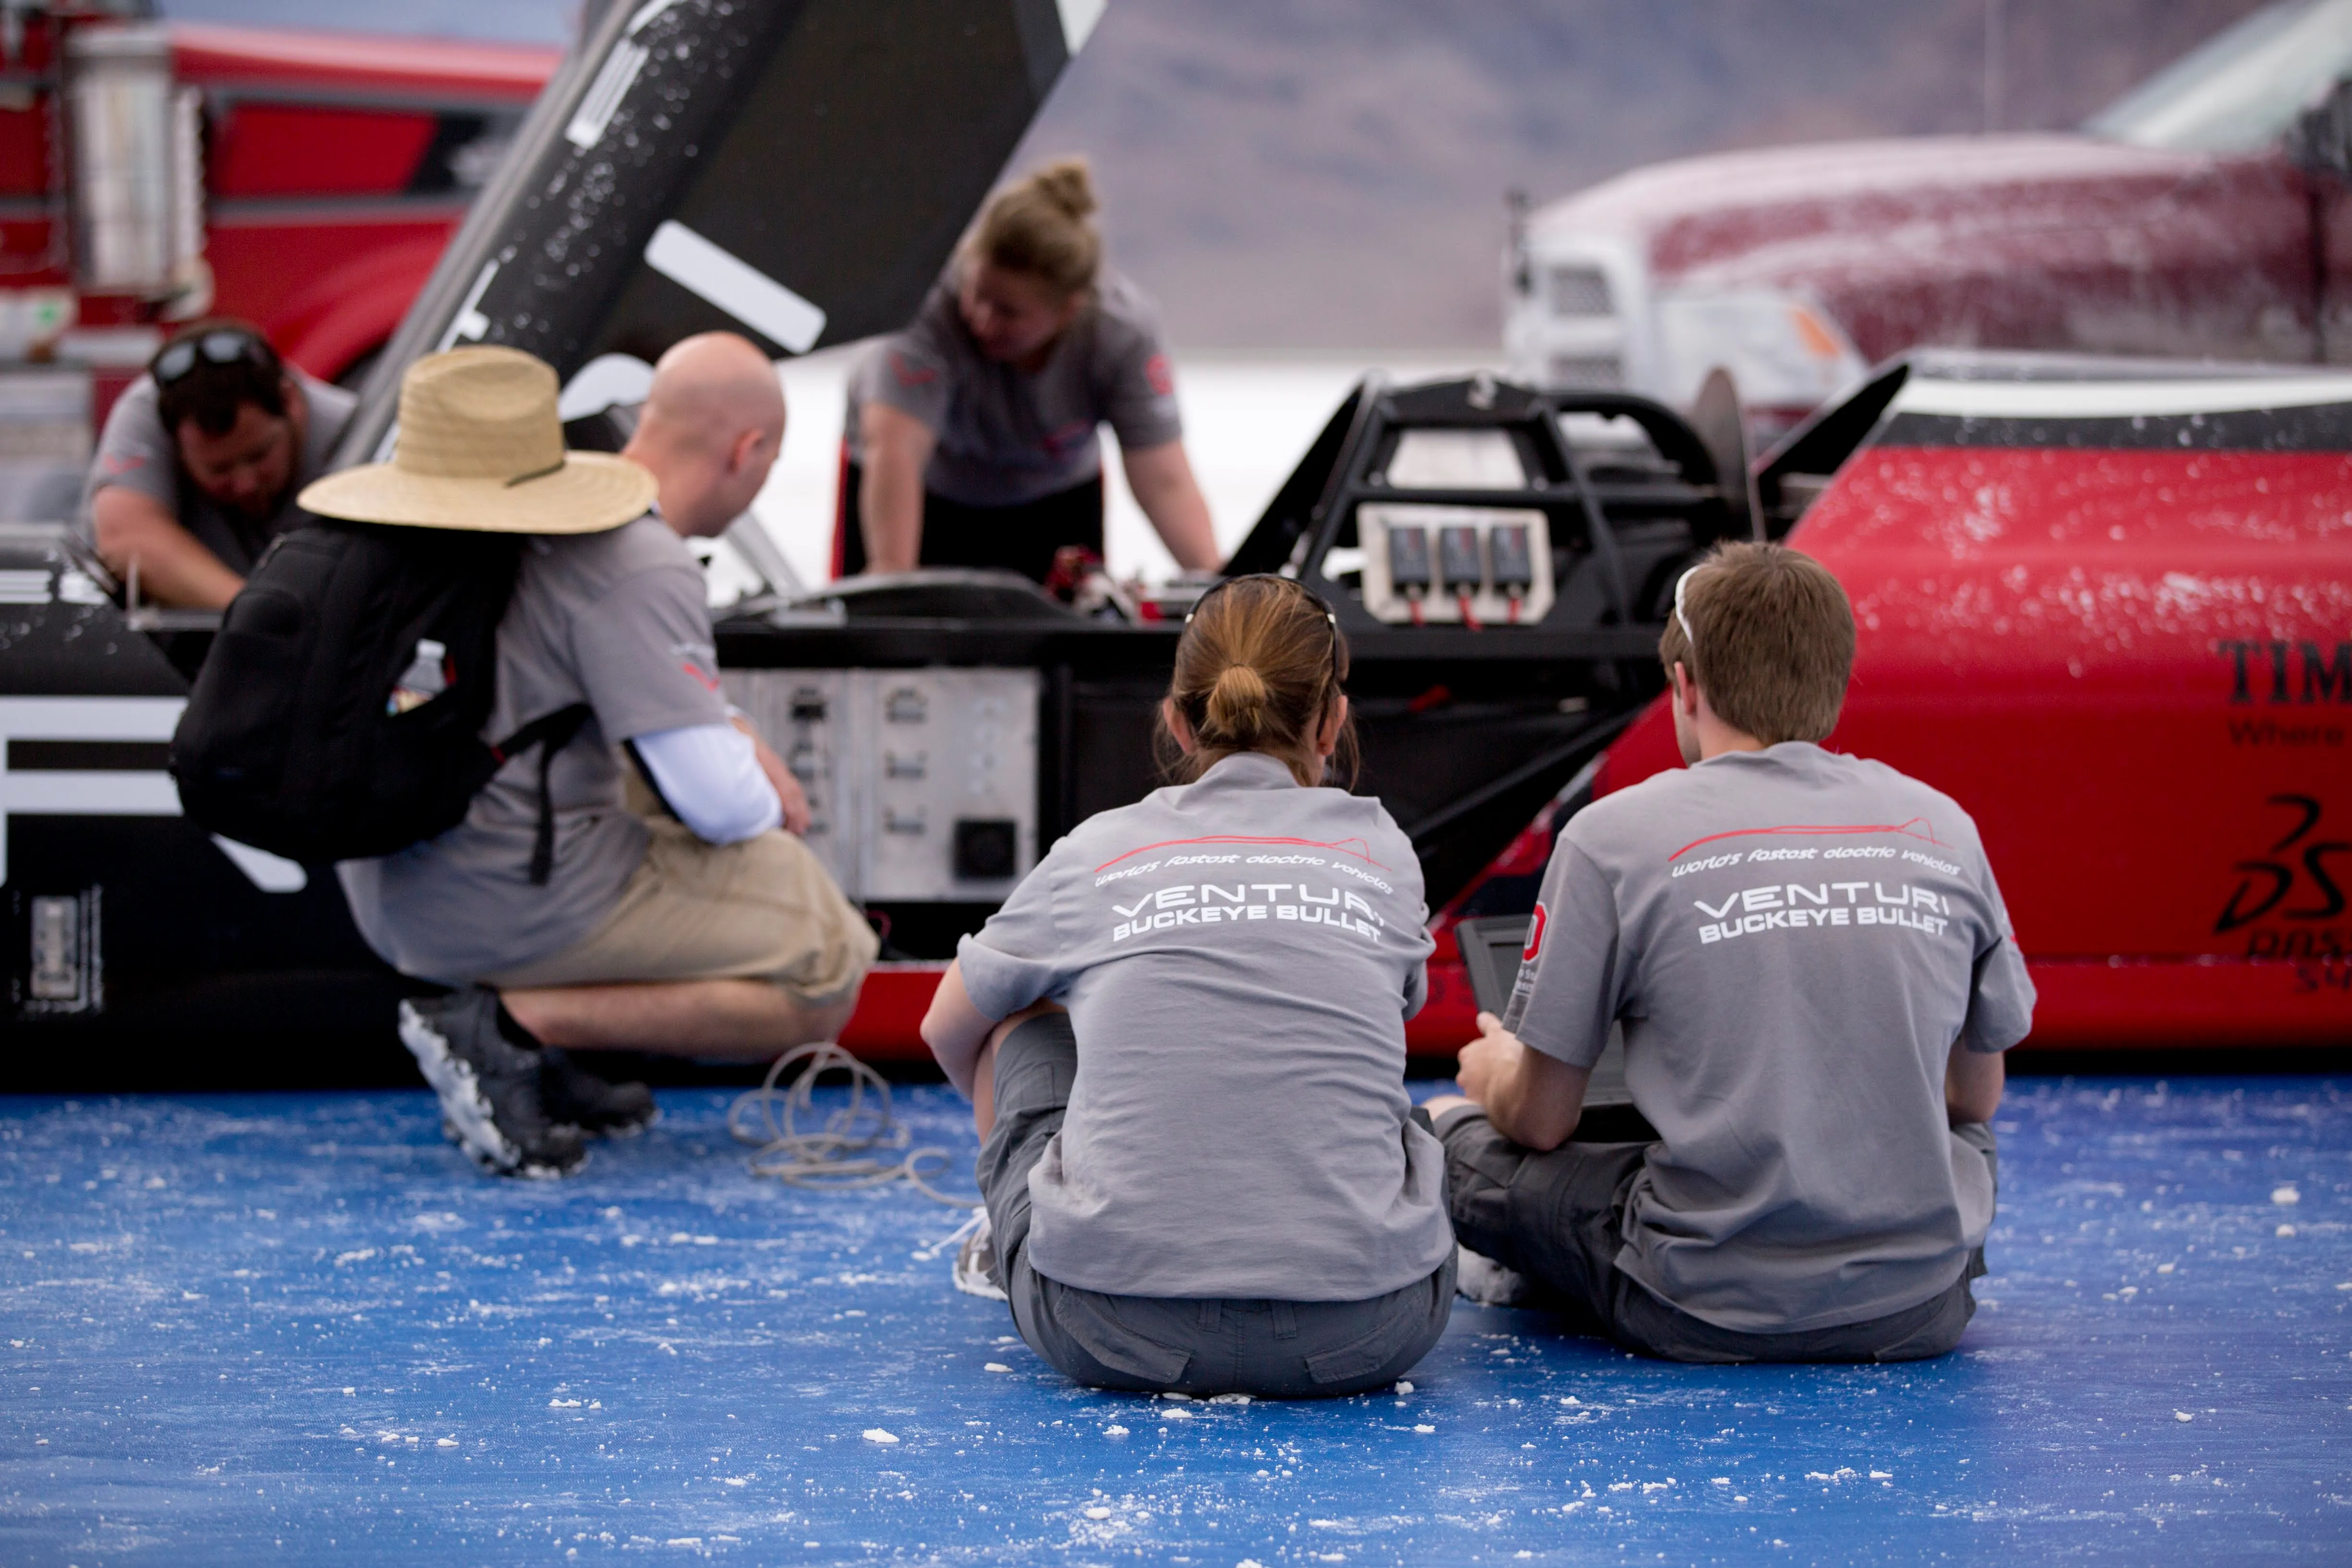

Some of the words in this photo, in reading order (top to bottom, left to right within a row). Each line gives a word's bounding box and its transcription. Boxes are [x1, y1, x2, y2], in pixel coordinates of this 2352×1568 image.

[1095, 861, 1161, 887] world's
[1164, 854, 1241, 867] fastest
[1246, 855, 1325, 865] electric
[1332, 862, 1393, 894] vehicles
[1672, 852, 1743, 878] world's
[1747, 848, 1819, 863] fastest
[1823, 846, 1896, 859] electric
[1901, 850, 1962, 876] vehicles
[1112, 884, 1384, 926] VENTURI
[1694, 881, 1950, 919] VENTURI
[1113, 905, 1267, 942] BUCKEYE
[1276, 905, 1381, 942] BULLET
[1698, 907, 1850, 944] BUCKEYE
[1856, 907, 1948, 936] BULLET
